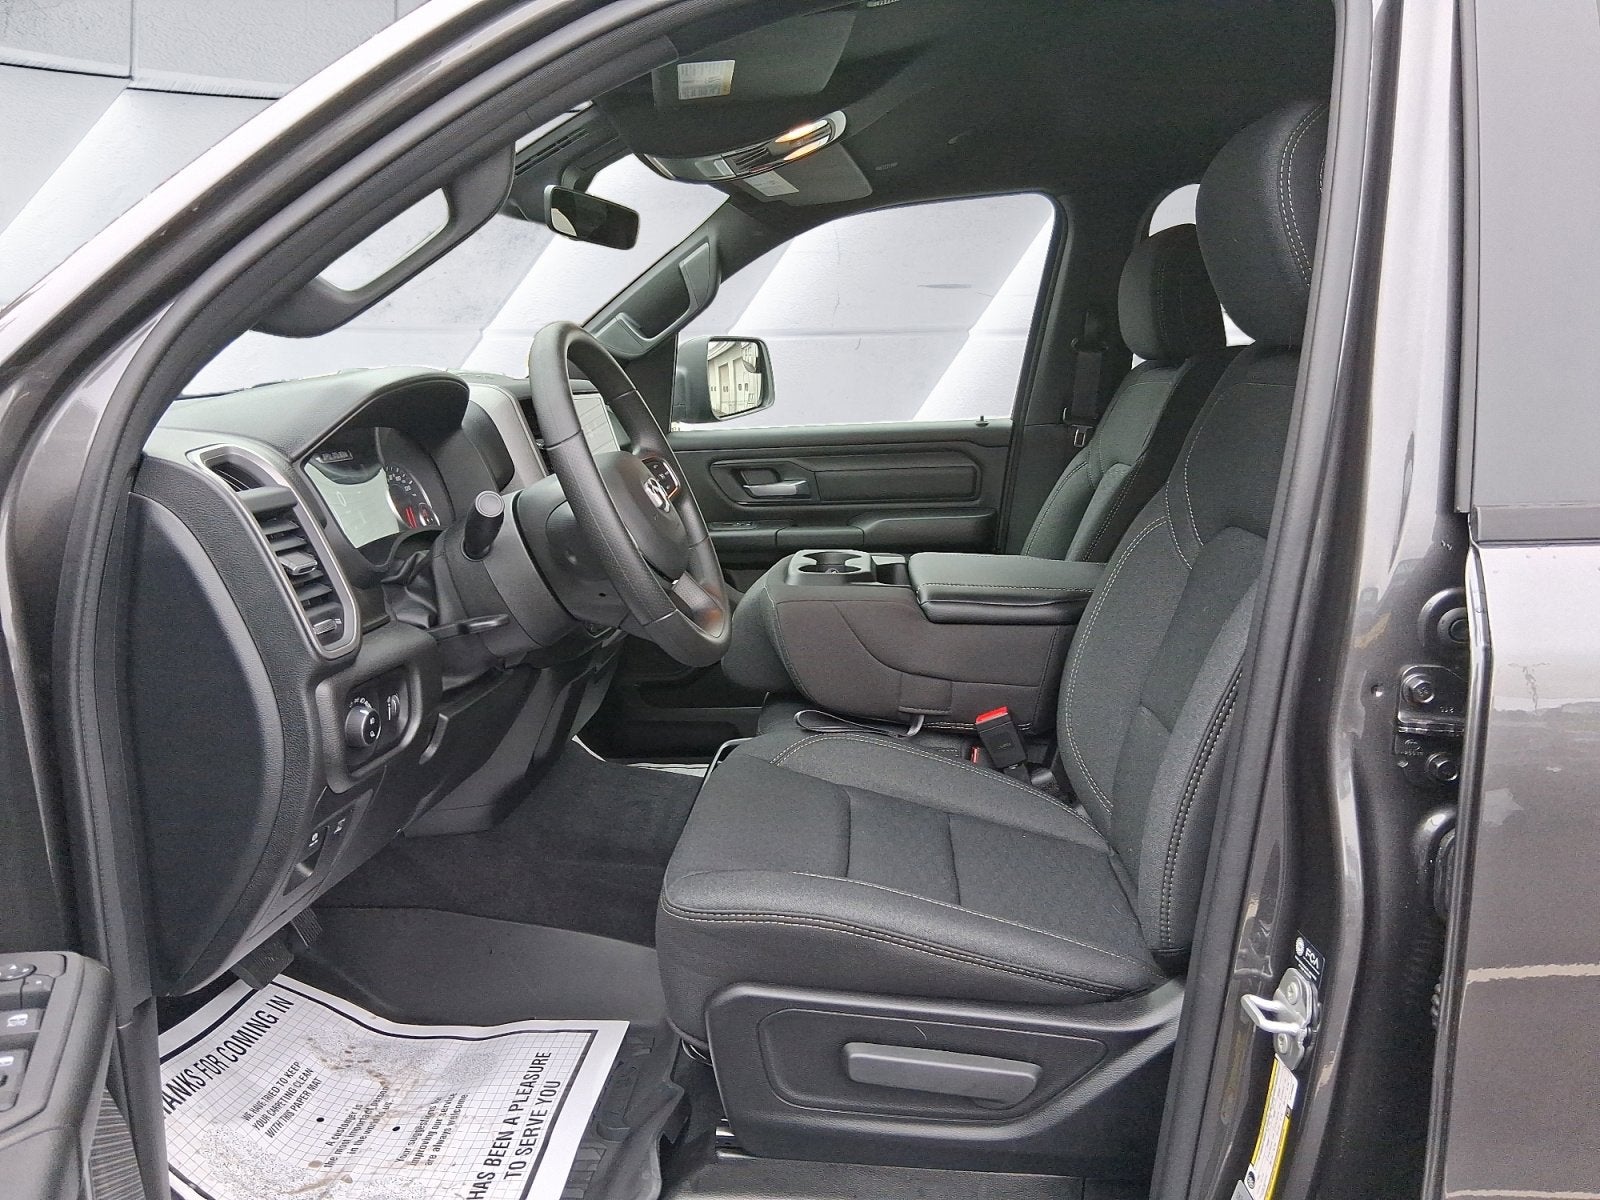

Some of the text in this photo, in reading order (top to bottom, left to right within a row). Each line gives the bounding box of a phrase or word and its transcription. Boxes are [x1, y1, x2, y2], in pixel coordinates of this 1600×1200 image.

[1305, 947, 1319, 969] FCA
[161, 995, 294, 1115] ANKS FOR COMING IN
[241, 1061, 301, 1121] WE HAVE TRIED TO KEEP
[252, 1067, 314, 1131] YOUR CARPETING CLEAN
[264, 1076, 322, 1138] WITH THIS PAPER MAT
[331, 1111, 358, 1140] customer
[347, 1147, 359, 1155] in
[353, 1135, 367, 1146] the
[466, 1052, 552, 1200] HAS BEEN A PLEASURE
[503, 1081, 561, 1180] TO SERVE YOU
[323, 1156, 338, 1167] the
